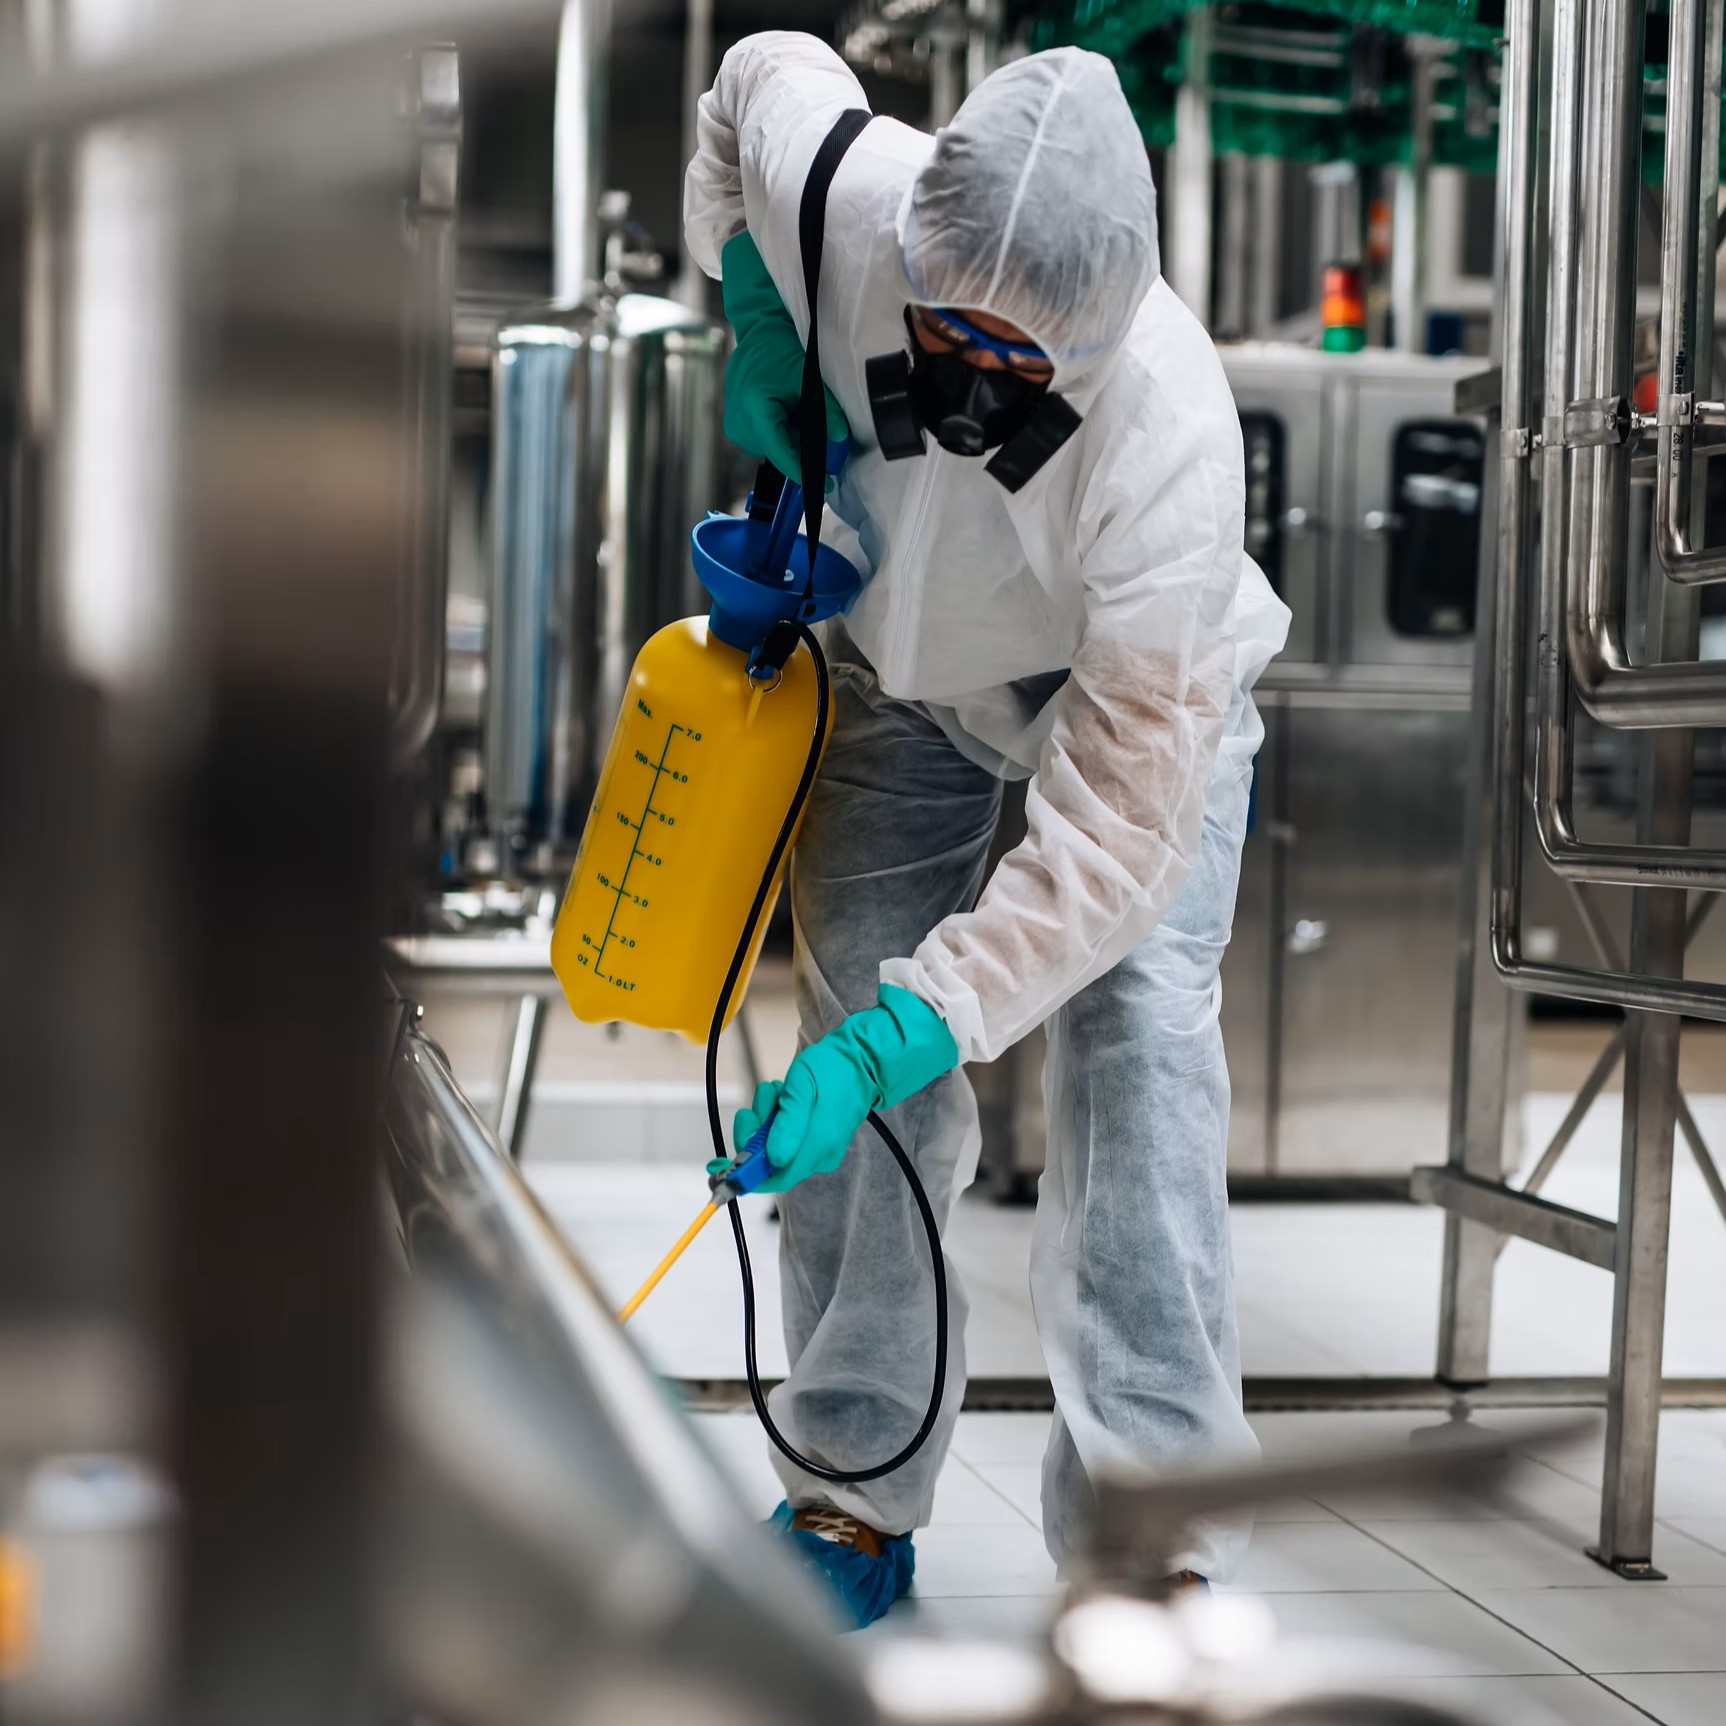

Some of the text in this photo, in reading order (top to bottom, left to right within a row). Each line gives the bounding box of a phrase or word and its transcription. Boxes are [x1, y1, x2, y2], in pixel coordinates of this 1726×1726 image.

[686, 728, 702, 741] 7.0
[634, 750, 648, 765] 200
[672, 771, 688, 783] 6.0
[616, 811, 629, 826] 150
[660, 813, 675, 826] 5.0
[646, 854, 662, 866] 4.0
[597, 873, 609, 887] 100
[633, 895, 649, 908] 3.0
[620, 936, 636, 948] 2.0
